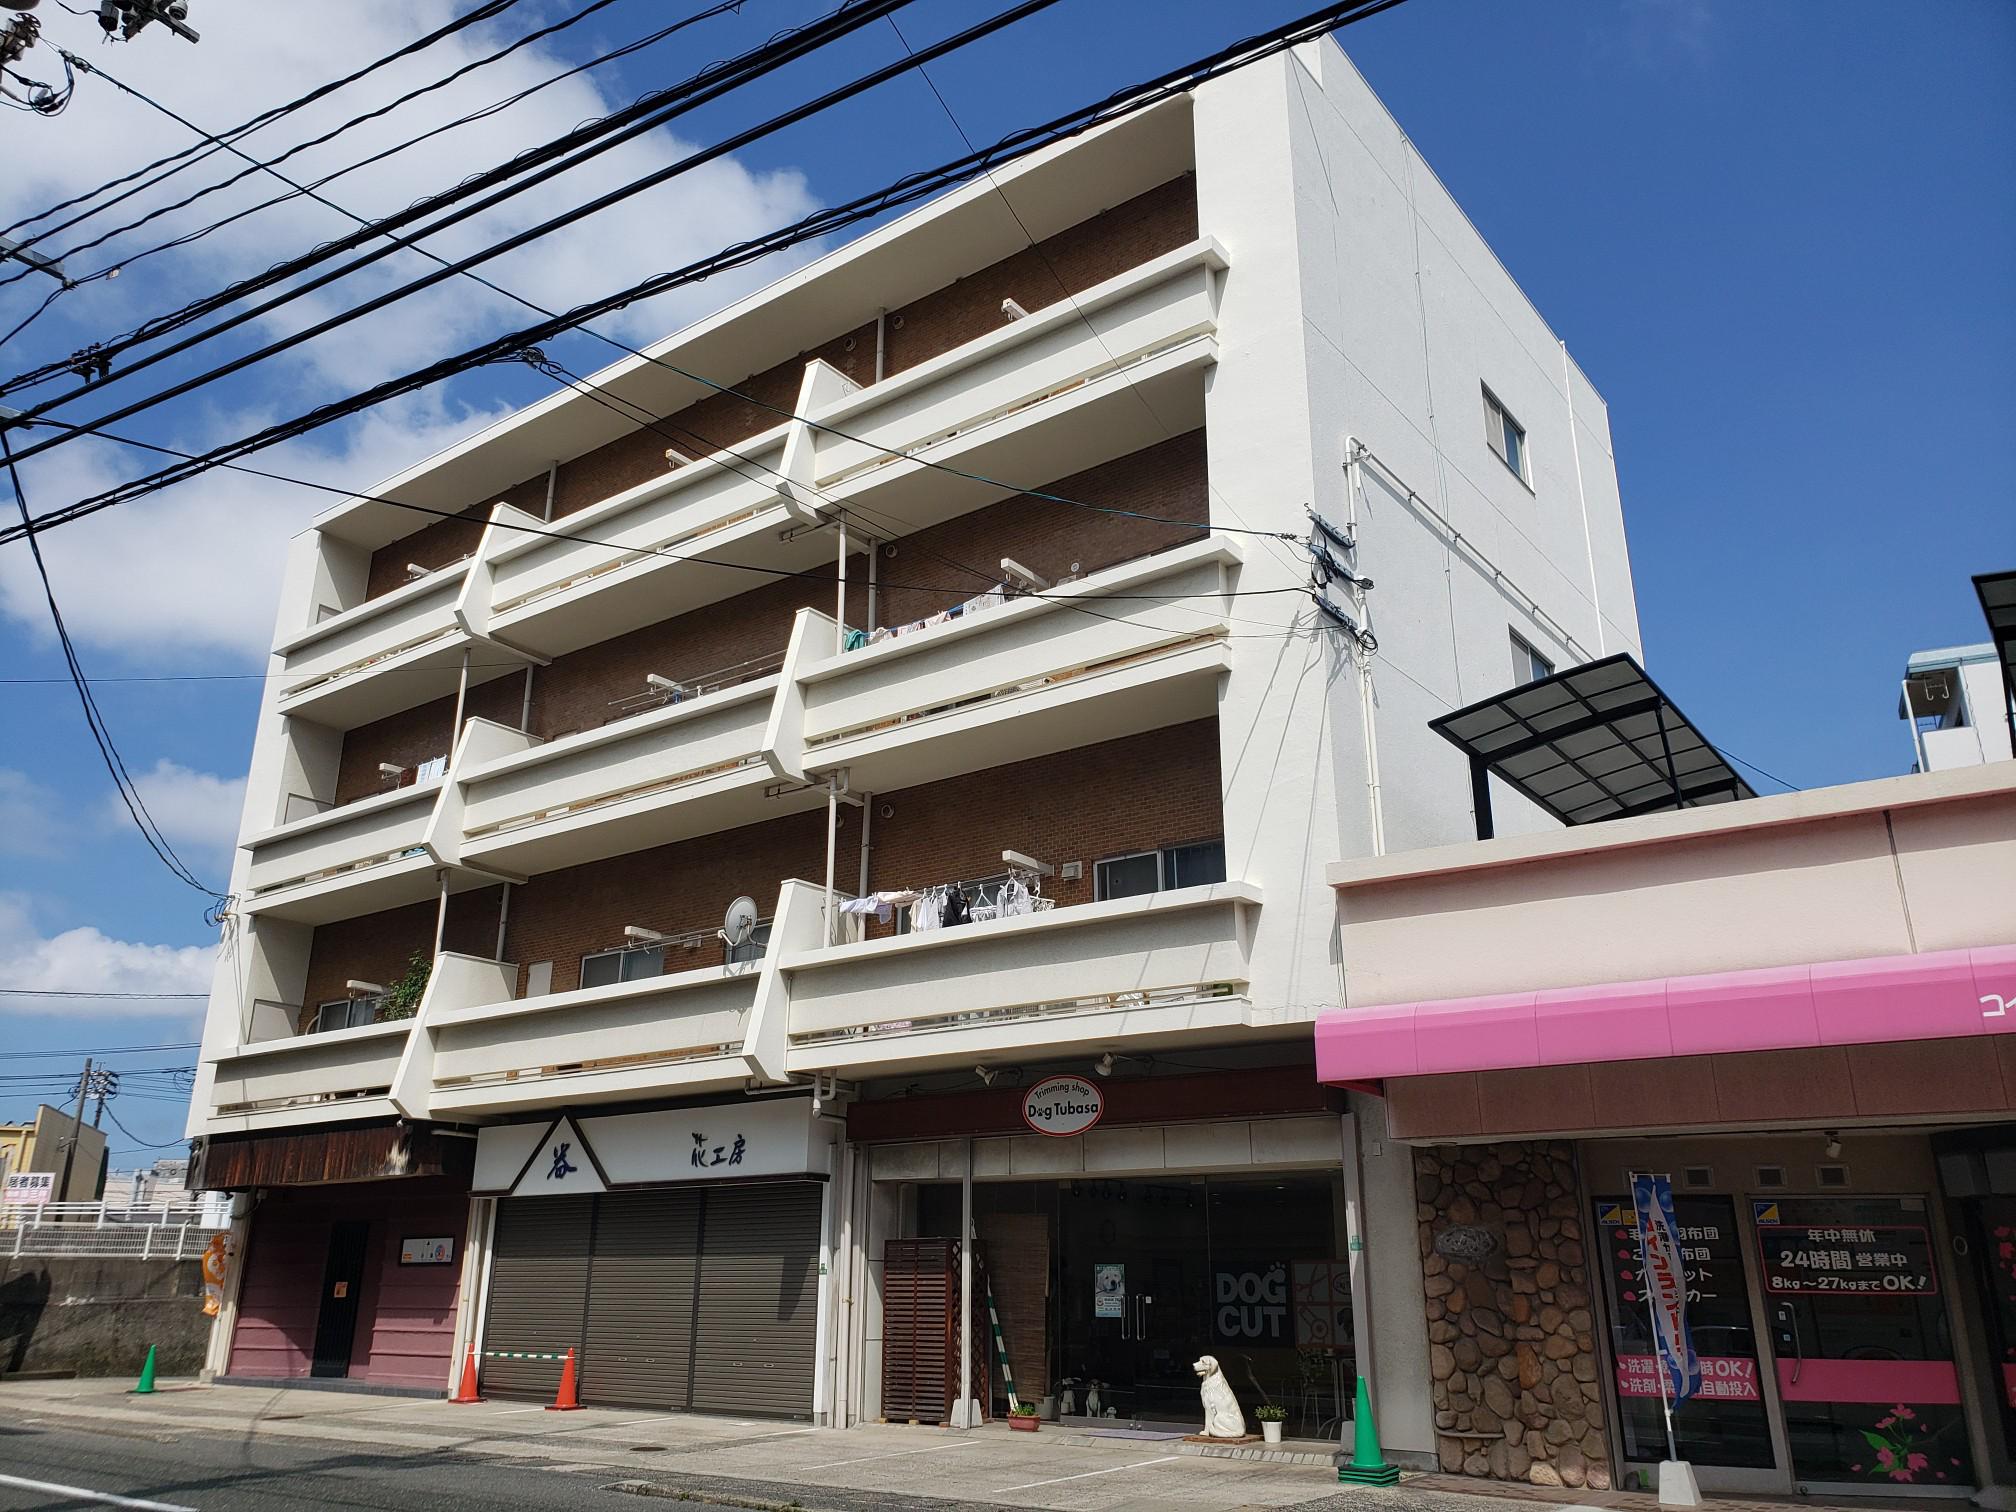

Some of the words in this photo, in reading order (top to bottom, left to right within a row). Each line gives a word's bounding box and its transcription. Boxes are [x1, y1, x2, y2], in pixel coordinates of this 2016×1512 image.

[1034, 1083, 1070, 1100] Trimming
[1072, 1082, 1090, 1097] shop
[1054, 1101, 1099, 1116] Tubasa
[691, 1132, 746, 1168] 花工房
[1807, 1229, 1876, 1243] 年中無休
[1780, 1250, 1851, 1270] 24時間
[1856, 1252, 1908, 1267] 営業中
[1216, 1271, 1287, 1304] DOG
[1217, 1305, 1288, 1338] CUT
